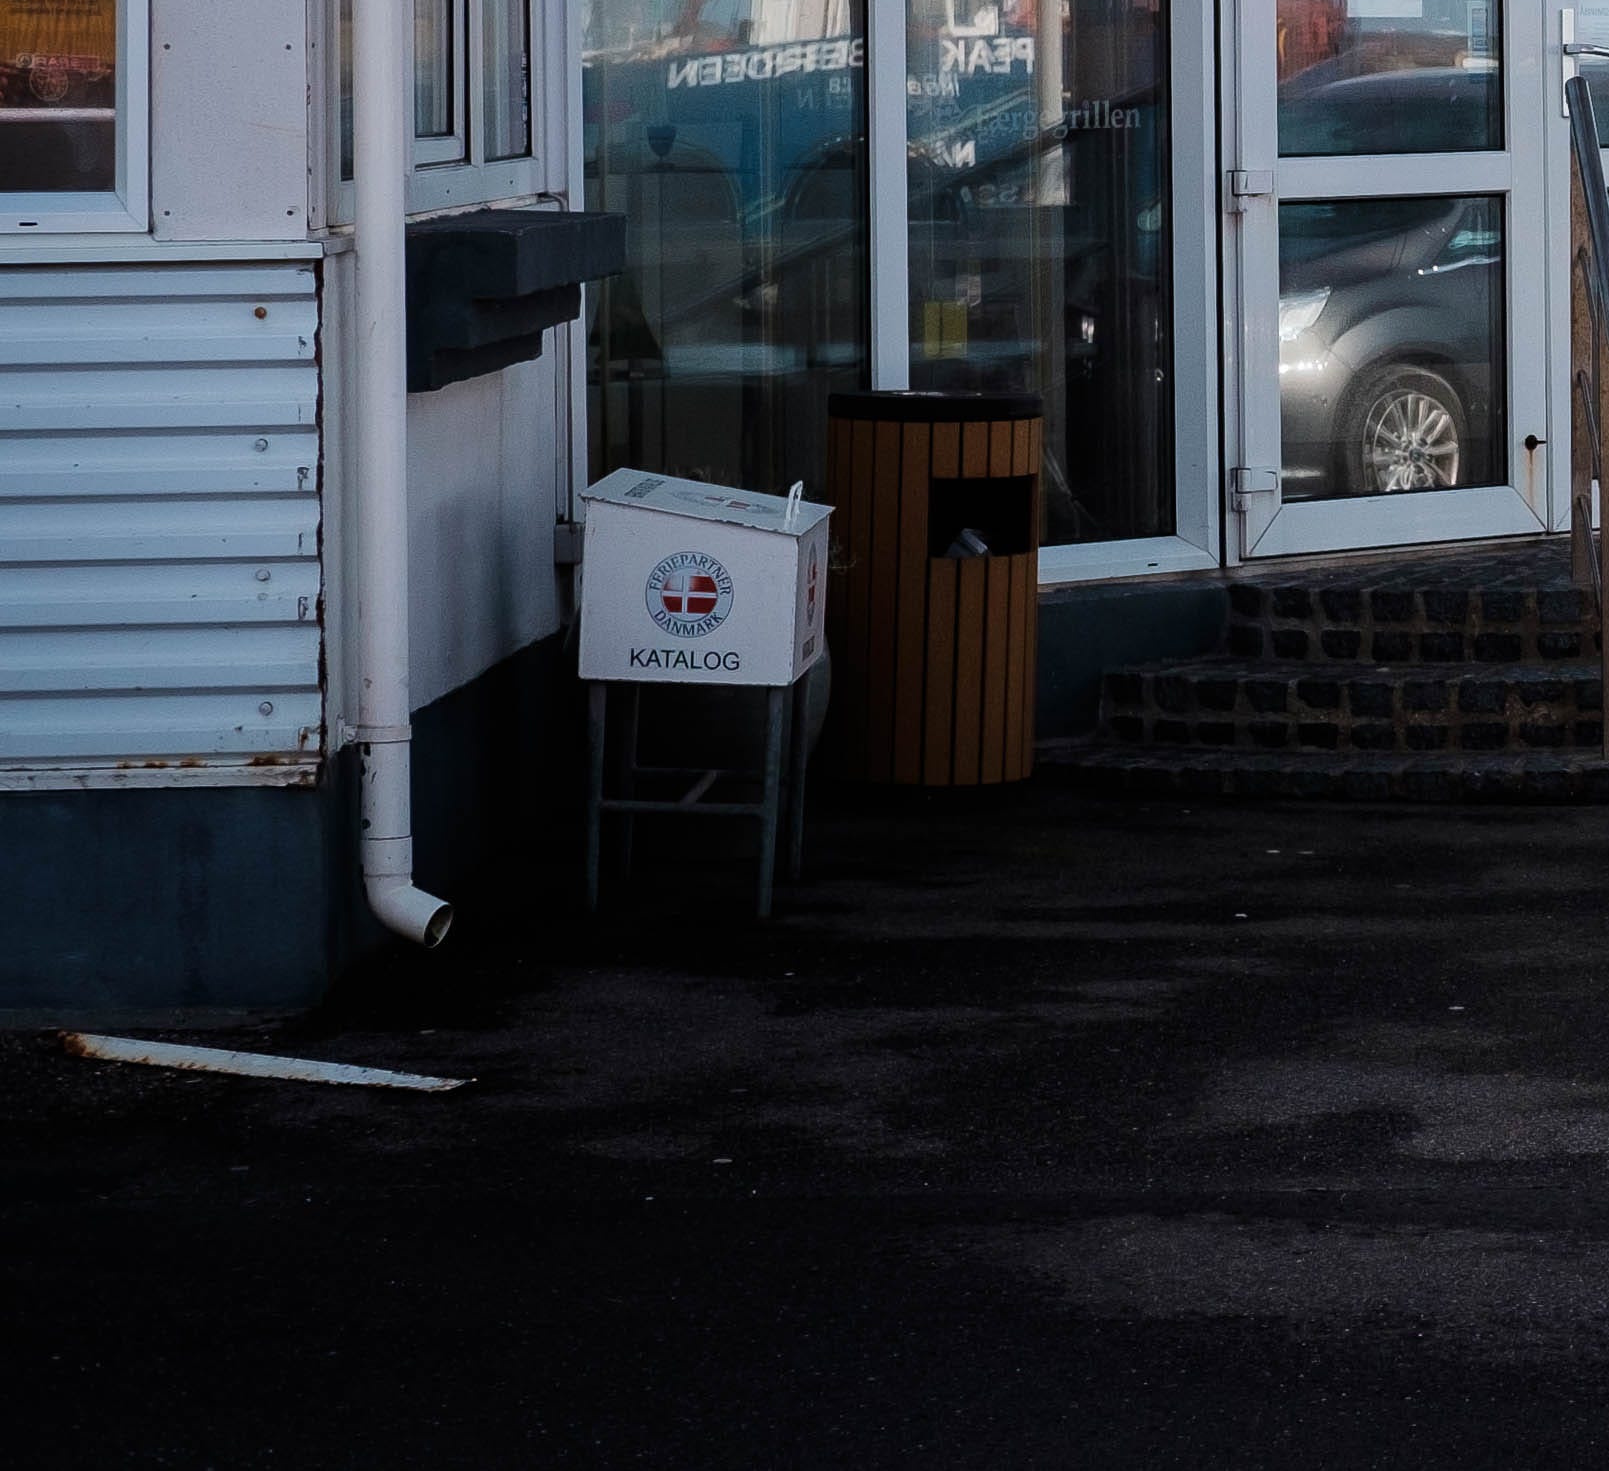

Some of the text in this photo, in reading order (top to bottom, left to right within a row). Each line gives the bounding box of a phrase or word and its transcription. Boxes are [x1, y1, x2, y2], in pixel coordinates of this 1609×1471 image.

[650, 553, 732, 596] FERIEPARTNER
[654, 611, 724, 636] DANMARK
[629, 647, 741, 671] KATALOG
